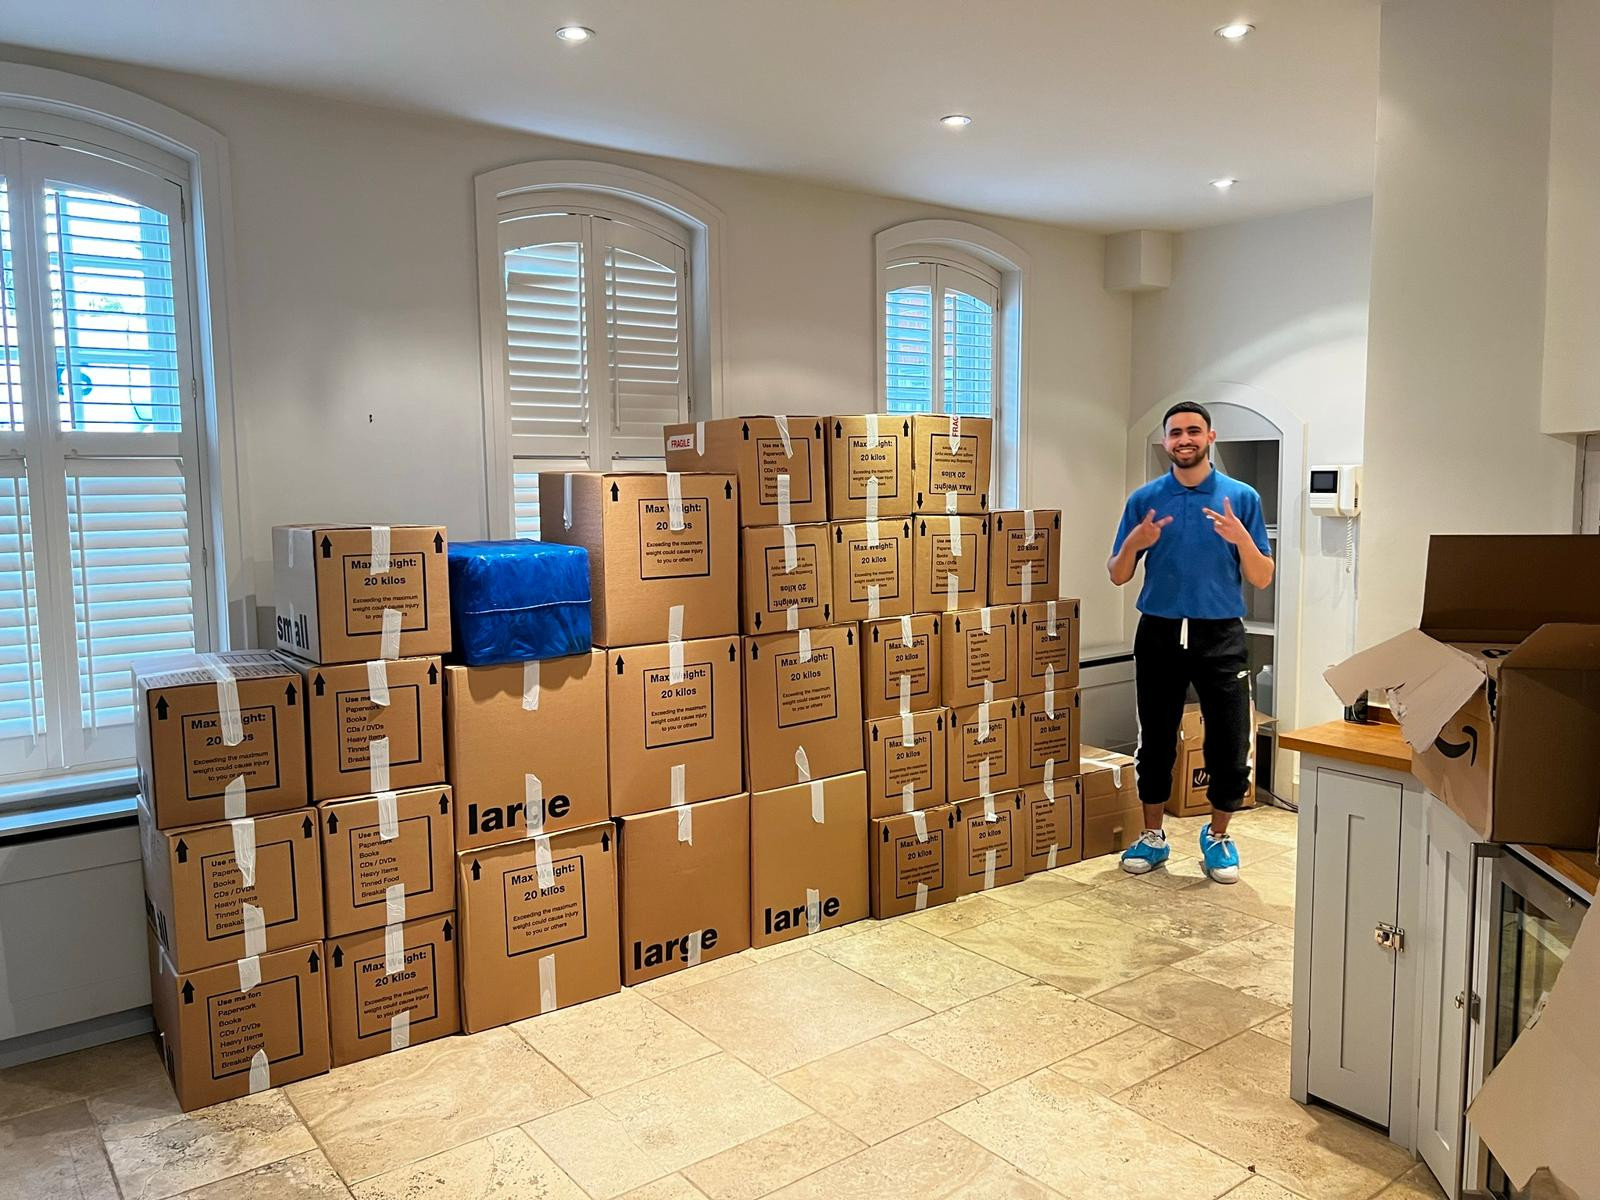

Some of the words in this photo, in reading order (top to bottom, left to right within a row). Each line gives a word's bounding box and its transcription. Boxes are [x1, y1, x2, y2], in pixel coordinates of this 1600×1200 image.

[671, 439, 690, 448] FRAGILE
[646, 505, 664, 513] Max
[668, 504, 701, 513] ight:
[657, 522, 668, 530] 20
[352, 560, 371, 569] Max
[378, 559, 416, 568] eight:
[364, 577, 377, 586] 20
[381, 576, 406, 585] kilos
[780, 584, 796, 592] kilos
[278, 614, 309, 650] small
[904, 640, 924, 648] ght:
[781, 659, 797, 667] Max
[799, 653, 828, 664] ight:
[650, 674, 669, 683] Max
[672, 670, 706, 680] eight:
[791, 673, 800, 681] 20
[803, 670, 821, 679] kilos
[661, 690, 672, 698] 20
[676, 688, 696, 696] kilos
[346, 705, 380, 713] Paperwork
[192, 719, 217, 729] Max
[223, 713, 266, 725] ght:
[206, 736, 221, 746] 20
[905, 737, 926, 745] ght:
[916, 835, 938, 845] Wght:
[918, 850, 932, 858] kilos
[212, 868, 241, 877] Paperw
[511, 874, 533, 885] Max
[536, 864, 575, 879] ight:
[213, 880, 235, 888] Books
[361, 880, 382, 888] Tinned
[214, 891, 229, 899] CDs
[235, 886, 255, 894] DVDs
[361, 888, 387, 898] Breakab
[524, 891, 537, 901] 20
[541, 885, 565, 897] kilos
[214, 900, 236, 909] Heavy
[216, 910, 239, 919] Tinned
[513, 911, 541, 921] Exceeding
[552, 902, 578, 912] maximum
[216, 920, 245, 930] Breakab
[512, 922, 531, 930] weight
[532, 918, 547, 926] could
[565, 911, 579, 919] injury
[532, 928, 542, 936] you
[551, 922, 567, 930] others
[634, 928, 718, 971] large
[362, 962, 384, 973] Max
[388, 952, 426, 966] ight:
[375, 977, 388, 987] 20
[392, 971, 416, 983] kilos
[218, 1003, 256, 1016] Paperwork
[218, 1018, 241, 1027] Books
[220, 1030, 234, 1038] CDs
[241, 1023, 260, 1031] DVDs
[220, 1038, 242, 1048] Heavy
[244, 1033, 263, 1042] Items
[221, 1048, 245, 1058] Tinned
[247, 1042, 264, 1051] Food
[222, 1055, 254, 1068] Breakab
